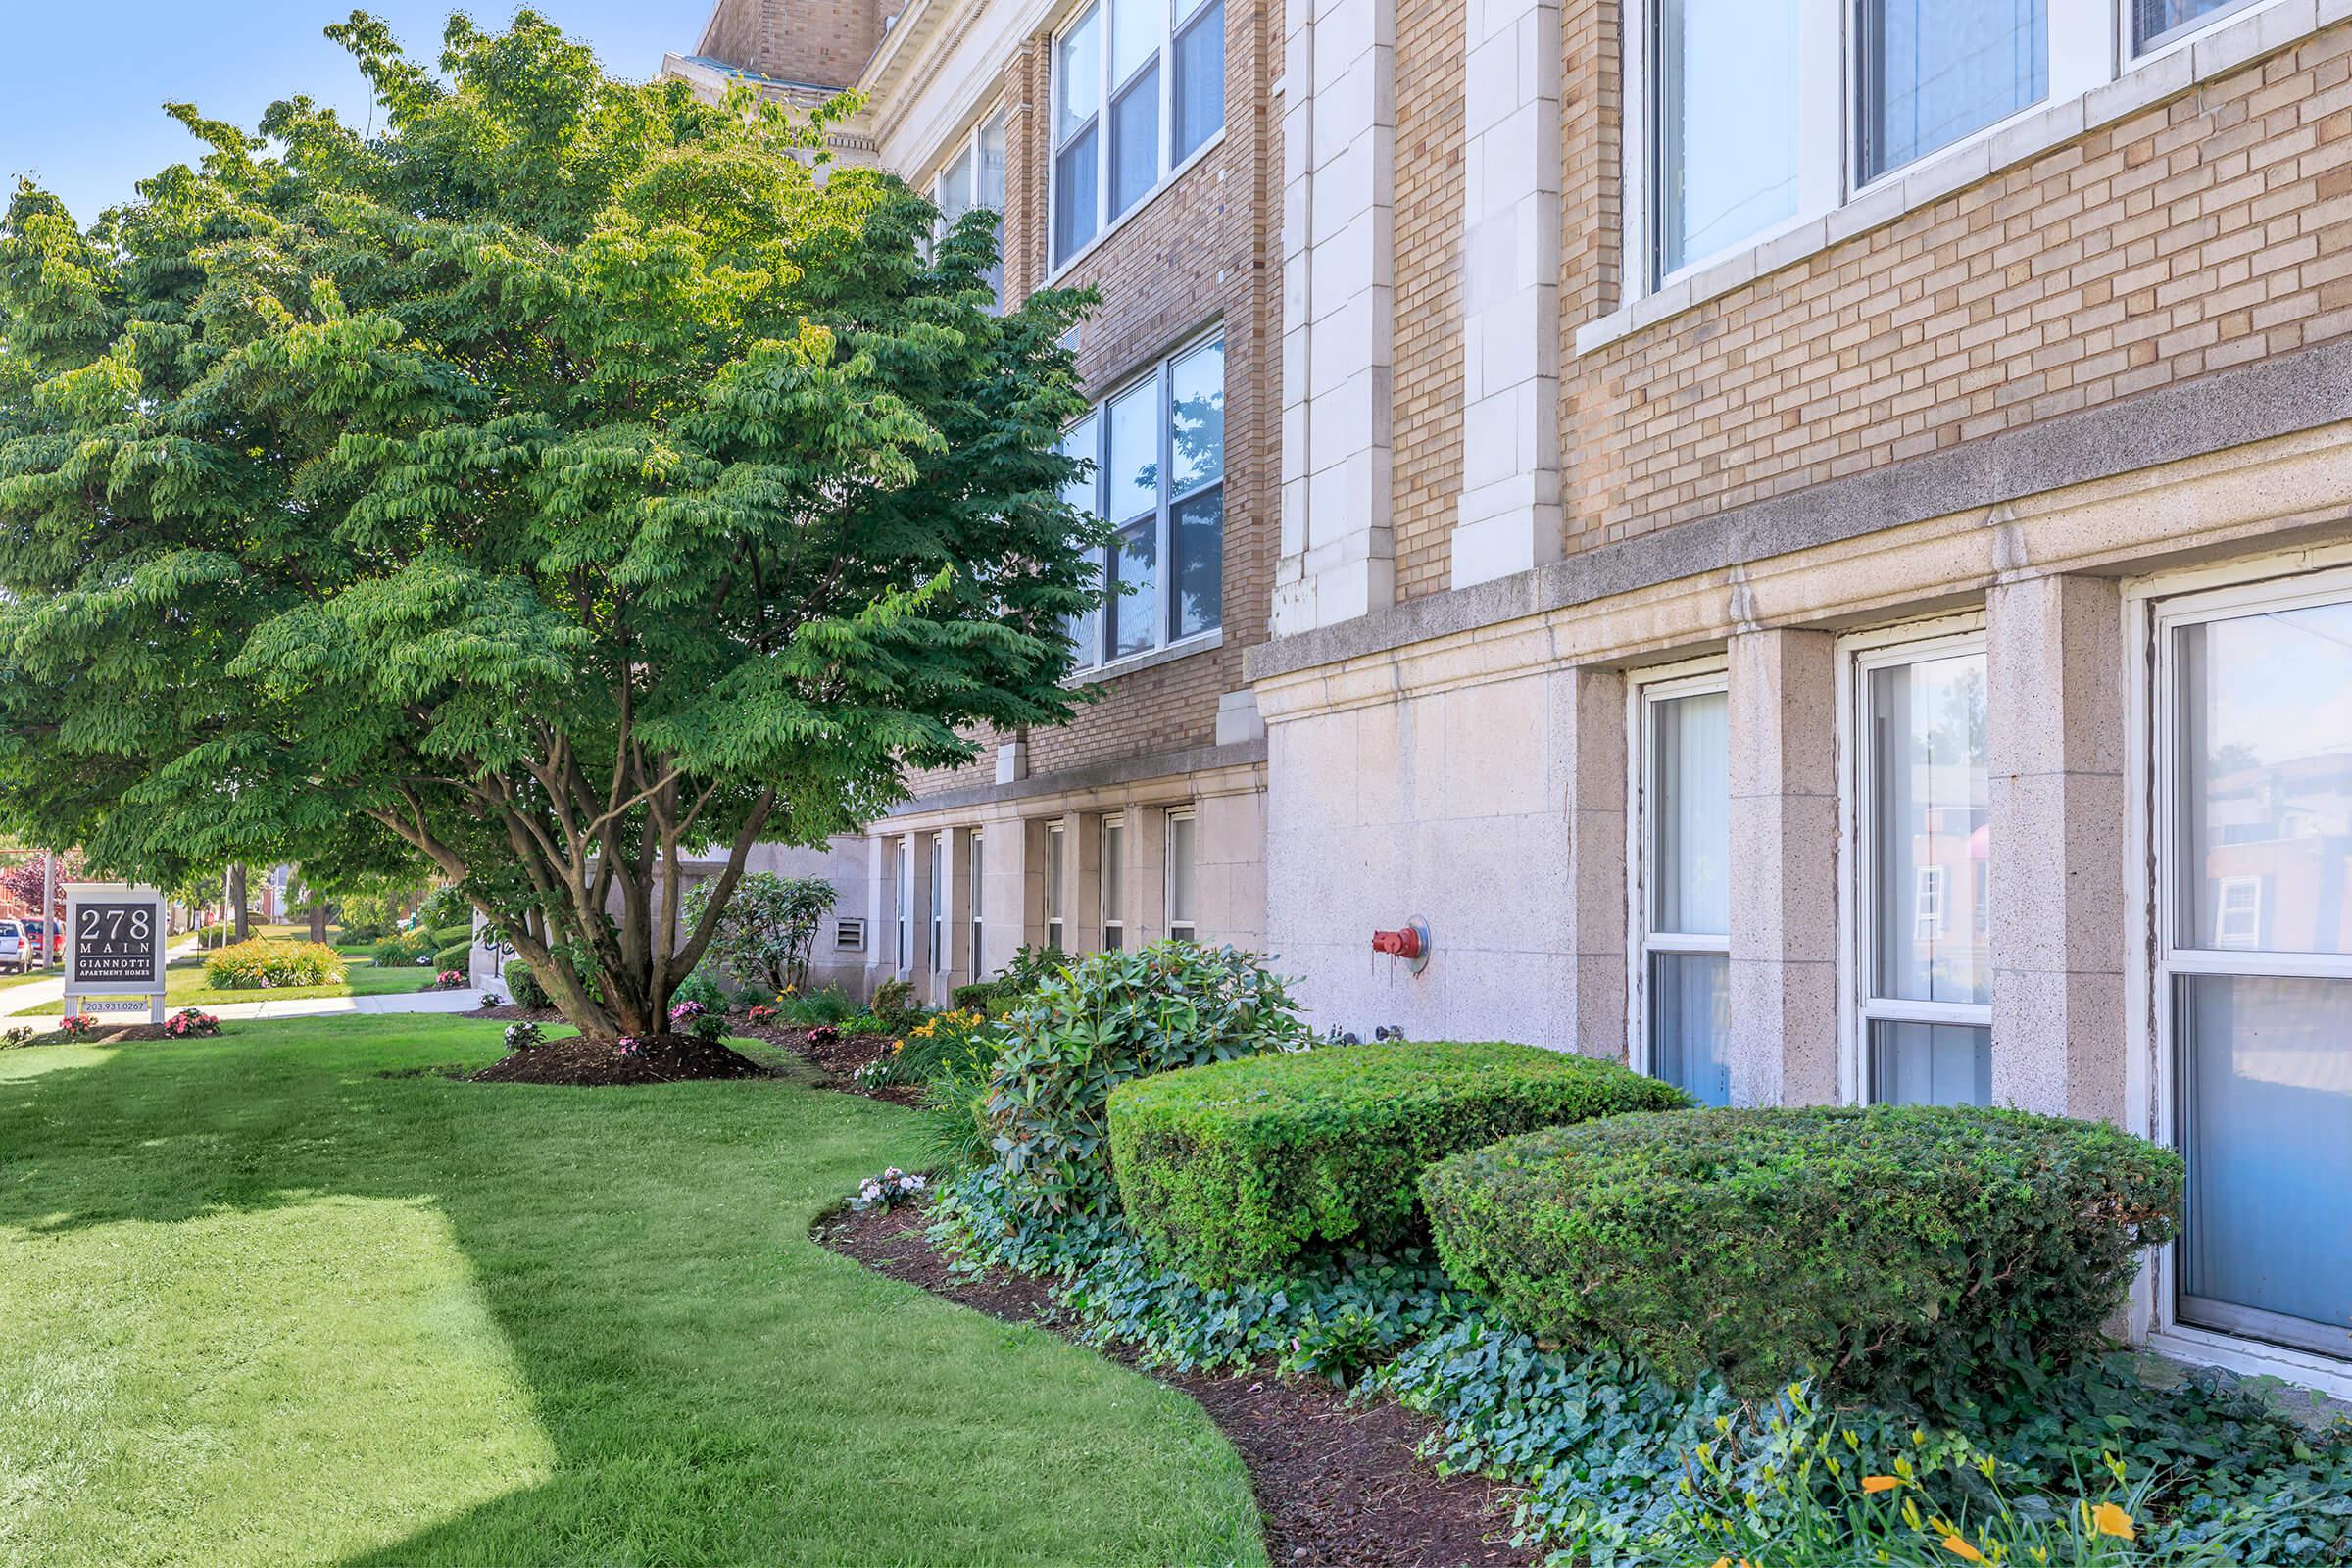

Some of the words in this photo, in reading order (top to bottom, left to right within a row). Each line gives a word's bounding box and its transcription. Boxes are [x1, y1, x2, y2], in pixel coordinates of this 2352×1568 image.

[80, 909, 150, 940] 278
[80, 942, 150, 953] MAIN
[79, 959, 150, 968] GIANNOTTI
[86, 1003, 144, 1011] 203.931.0267
